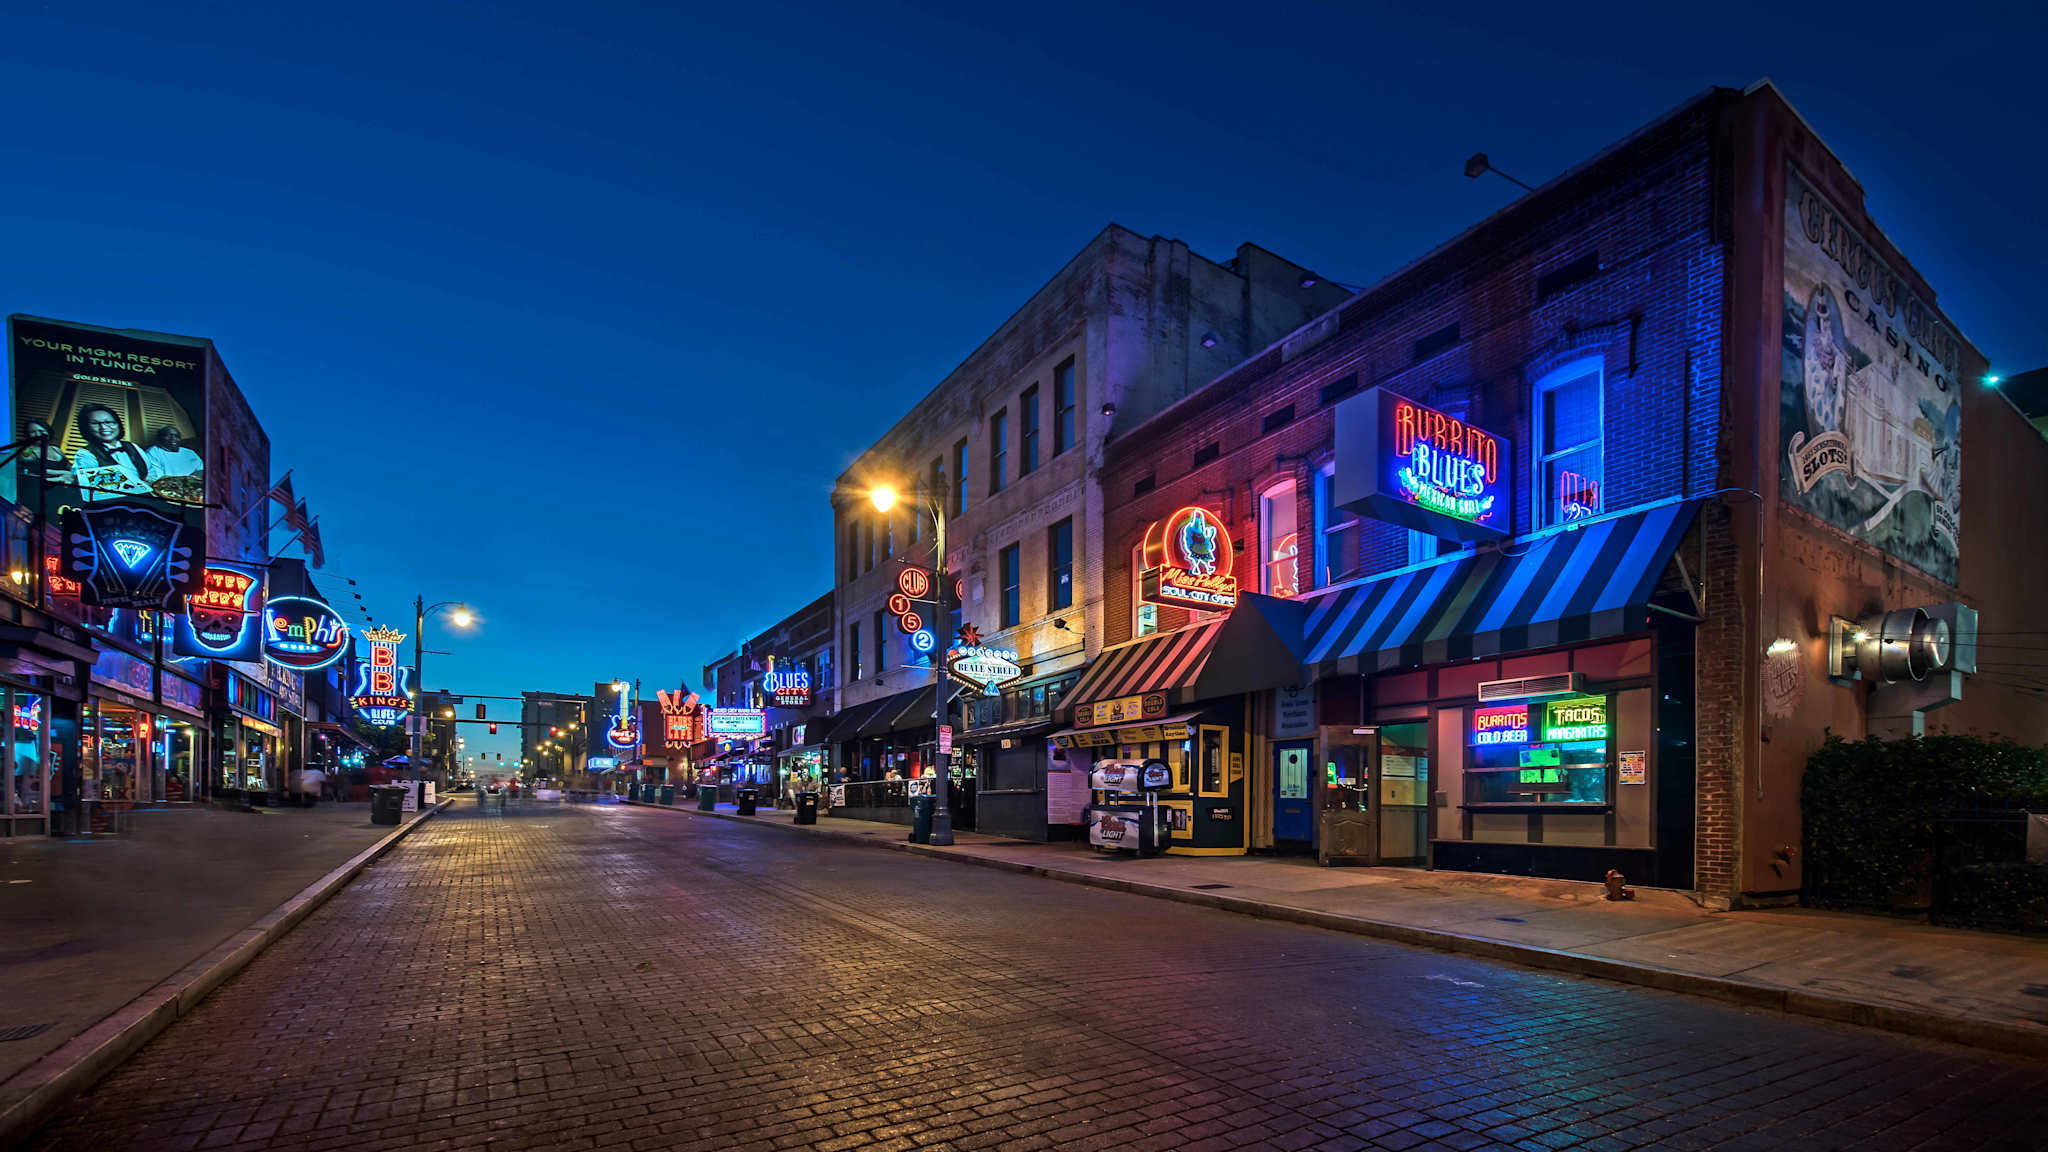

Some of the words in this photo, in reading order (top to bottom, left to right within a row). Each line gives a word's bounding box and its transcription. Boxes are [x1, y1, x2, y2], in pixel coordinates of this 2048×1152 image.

[1845, 290, 1946, 391] CASINO
[20, 336, 73, 353] YOUR
[78, 346, 122, 360] MGM
[127, 353, 197, 371] RESORT
[66, 353, 84, 364] IN
[90, 357, 156, 374] TUNICA
[73, 373, 99, 382] GOLD
[1396, 405, 1497, 484] BURRITO
[1412, 444, 1485, 495] BLUES
[1803, 448, 1848, 482] SLOTS!
[1420, 482, 1456, 511] MEXICAN
[202, 569, 247, 590] ATER
[902, 571, 926, 595] CLUB
[1163, 585, 1188, 598] SOUL
[895, 597, 904, 612] 1
[907, 615, 918, 630] 5
[918, 632, 930, 648] 2
[374, 646, 393, 667] B
[958, 663, 985, 673] BEALE
[987, 665, 1018, 676] STREET
[374, 671, 393, 692] B
[763, 672, 808, 692] BLUES
[776, 688, 809, 696] CITY
[358, 697, 409, 708] KING'S
[371, 708, 395, 719] BLUES
[1477, 712, 1528, 731] BURRITOS
[1553, 707, 1602, 726] TACOS
[1477, 731, 1500, 744] COLD
[1502, 730, 1528, 743] BEER
[1547, 725, 1606, 741] MARGARITAS
[1102, 830, 1125, 840] LIGHT
